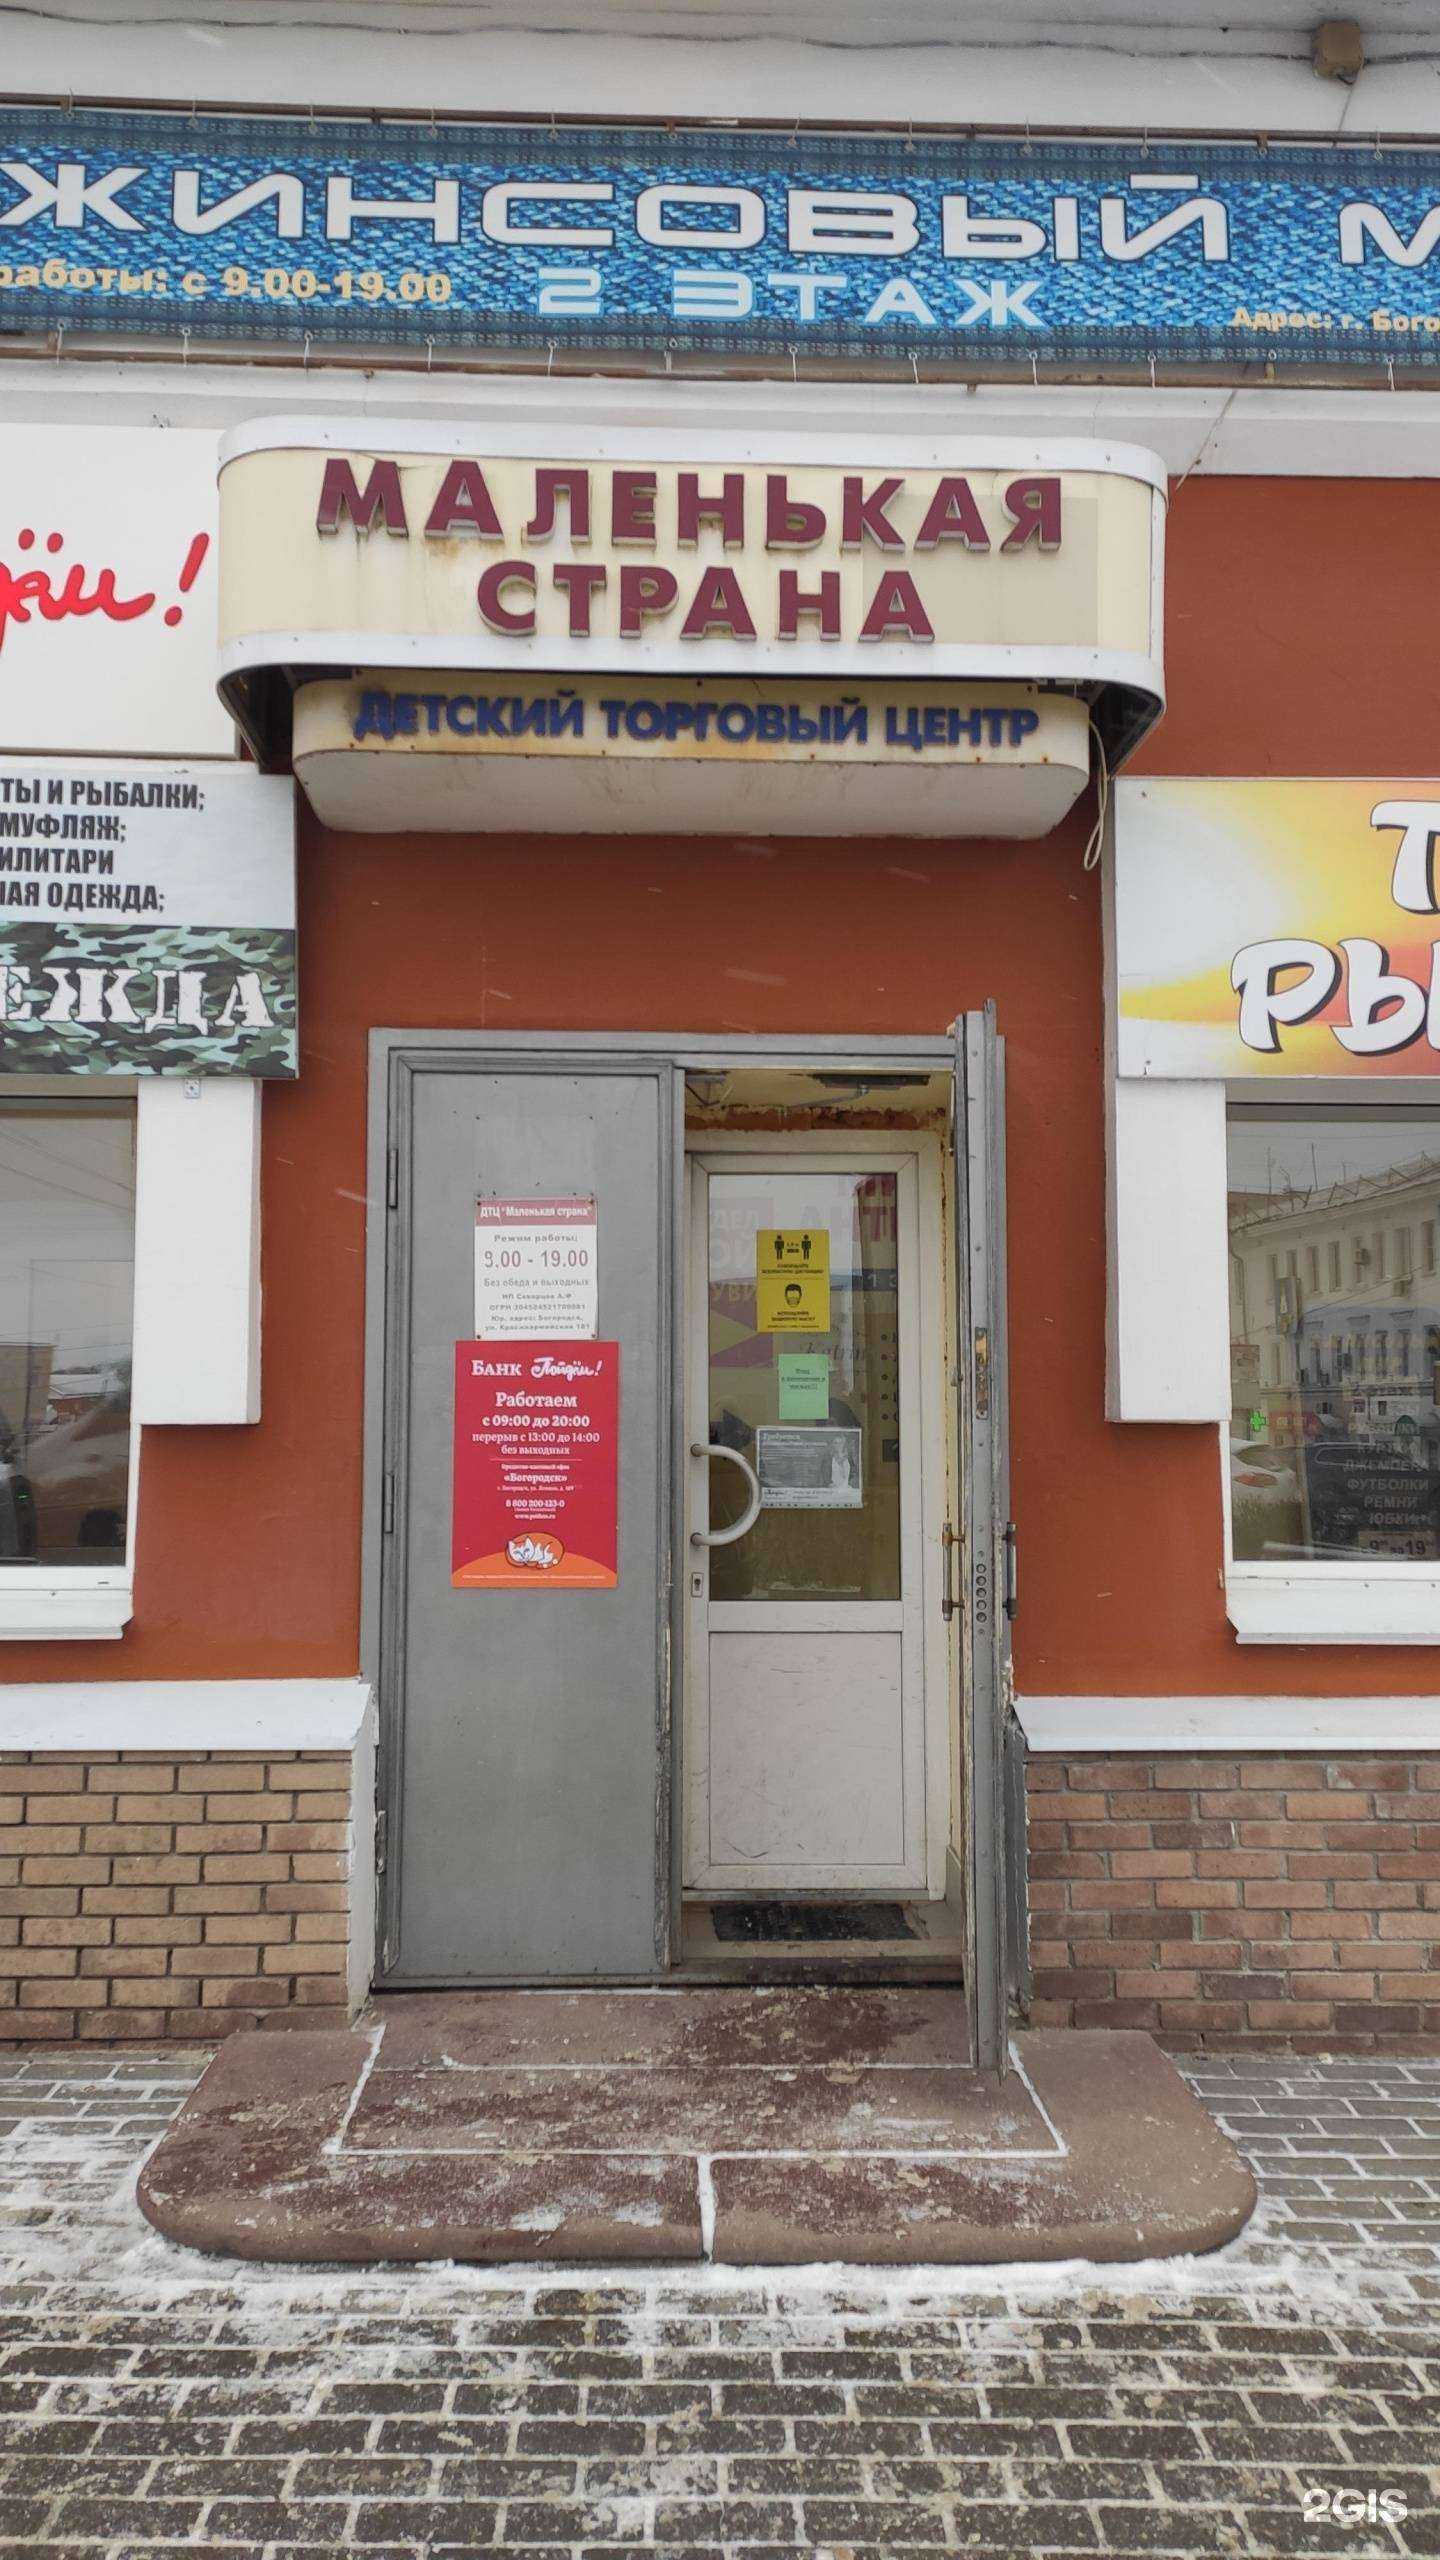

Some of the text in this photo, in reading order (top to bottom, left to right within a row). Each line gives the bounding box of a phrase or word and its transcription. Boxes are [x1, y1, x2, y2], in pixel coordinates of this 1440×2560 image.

[183, 277, 207, 294] с
[223, 267, 452, 302] 9.00-19.00
[537, 266, 1045, 327] 2 ЭТАЖ
[1231, 306, 1334, 332] Адрес:
[316, 457, 1062, 551] МАЛЕНЬКАЯ
[477, 560, 936, 642] СТРАНА
[353, 688, 1039, 753] ДЕТСКИЙ ТОРГОВЫЙ ЦЕНТР
[0, 777, 204, 812] ТЫ И РЫБАЛКИ;
[0, 812, 126, 842] МУФЛЯЖ;
[47, 882, 165, 914] ОДЕЖДА;
[480, 1206, 500, 1218] ДТЦ
[494, 1233, 578, 1245] Режим работы:
[540, 1250, 588, 1267] 19.00
[483, 1278, 500, 1287] Без
[495, 1391, 577, 1407] Работаем
[482, 1415, 590, 1429] с 09:00 до 20:00
[472, 1432, 600, 1445] перерыв с 13:00 до 14:00
[501, 1444, 570, 1456] без выходных
[503, 1472, 568, 1484] «Богородск»
